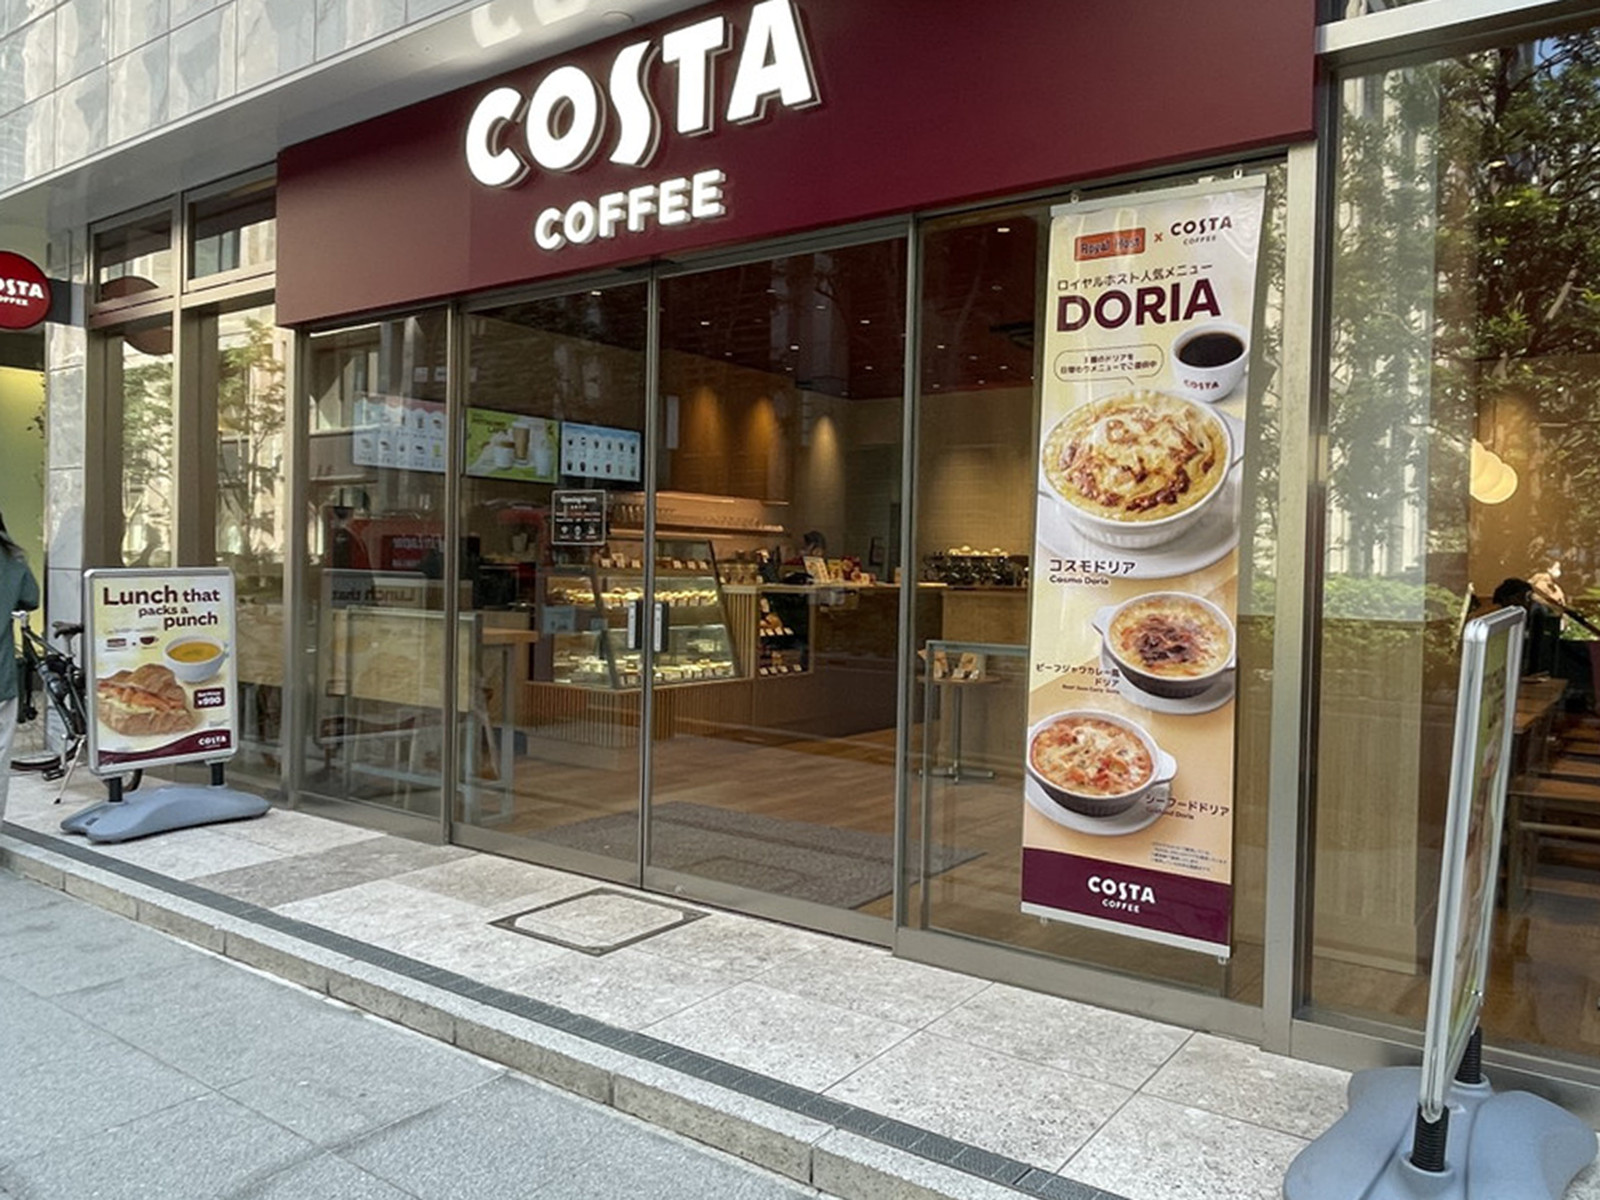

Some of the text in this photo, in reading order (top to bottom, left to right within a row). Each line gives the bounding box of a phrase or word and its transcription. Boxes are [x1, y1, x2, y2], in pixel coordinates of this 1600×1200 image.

[465, 0, 820, 188] COSTA
[534, 168, 726, 251] COFFEE
[1080, 241, 1110, 255] Royal
[1170, 216, 1232, 236] COSTA
[1183, 235, 1217, 246] COFFEE
[1057, 264, 1213, 291] ロイヤルホスト人気メニュー
[0, 277, 44, 299] STA
[0, 295, 28, 306] FFEE
[1057, 278, 1221, 332] DORIA
[1183, 379, 1220, 390] COSTA
[1049, 559, 1136, 574] コスモドリア
[1049, 575, 1109, 586] Cosmo Doria
[103, 585, 220, 605] Lunch that
[138, 604, 189, 618] packs a
[164, 611, 218, 631] punch
[1094, 677, 1119, 688] ドリア
[198, 735, 227, 746] COSTA
[1146, 794, 1230, 816] シーフードドリア
[1087, 876, 1156, 904] COSTA
[1102, 898, 1141, 914] COFFEE
